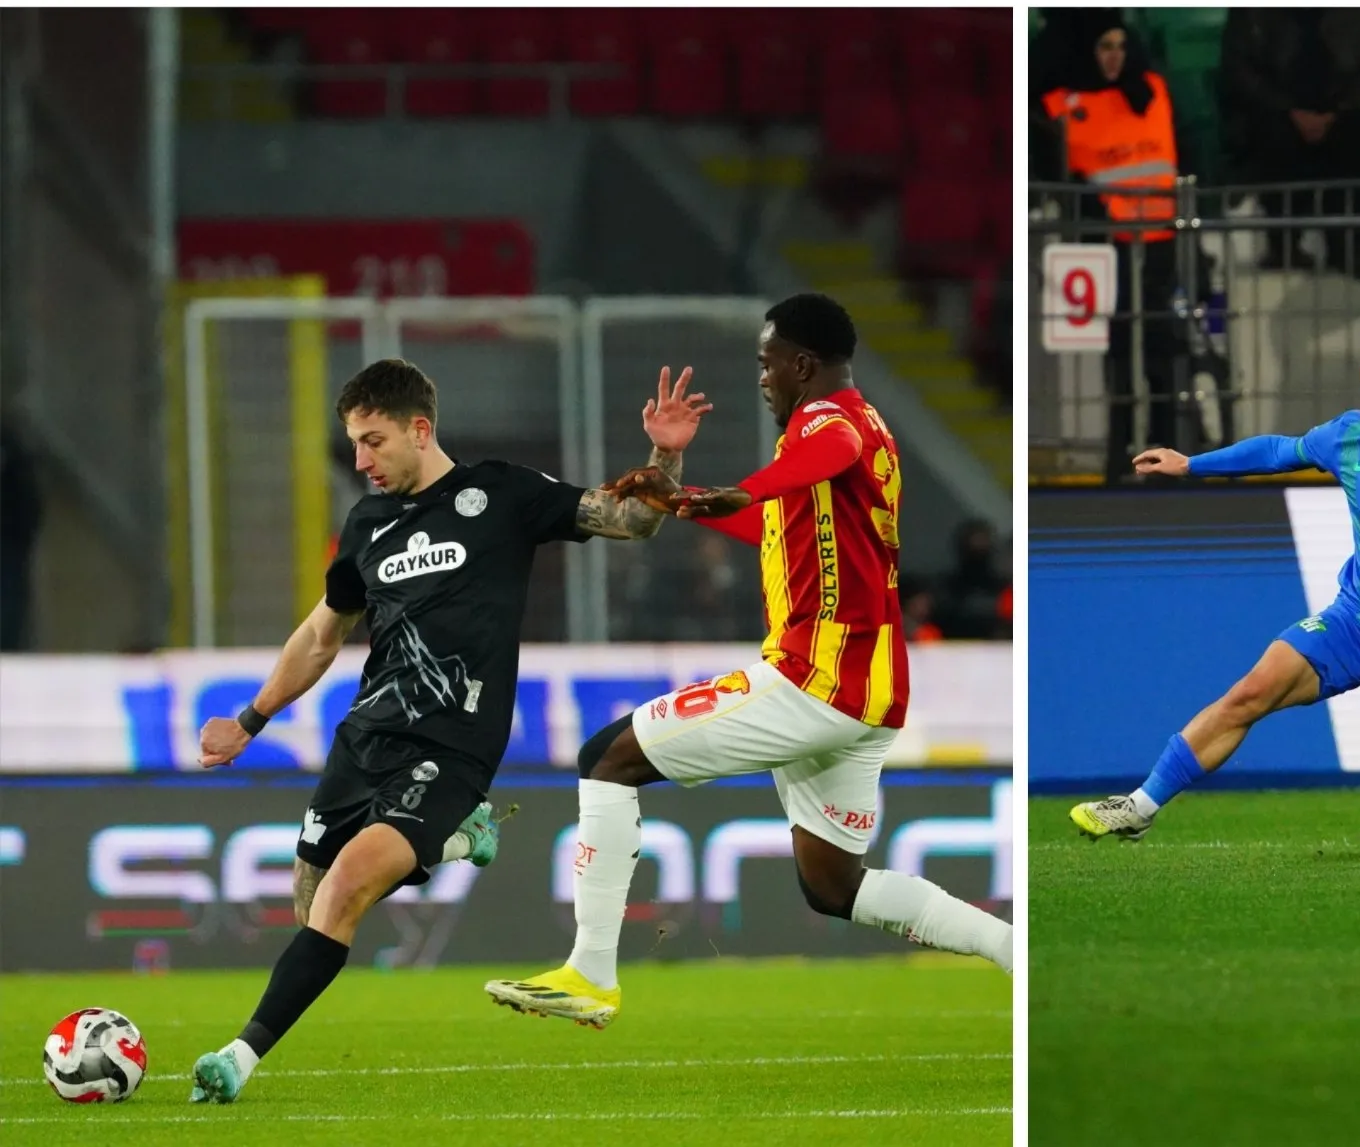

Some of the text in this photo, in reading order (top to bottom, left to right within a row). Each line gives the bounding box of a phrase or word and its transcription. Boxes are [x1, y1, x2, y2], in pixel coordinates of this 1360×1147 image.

[1061, 264, 1098, 330] 9
[383, 546, 458, 582] ÇAYKUR
[816, 512, 839, 622] SOLARES
[400, 783, 428, 811] 6
